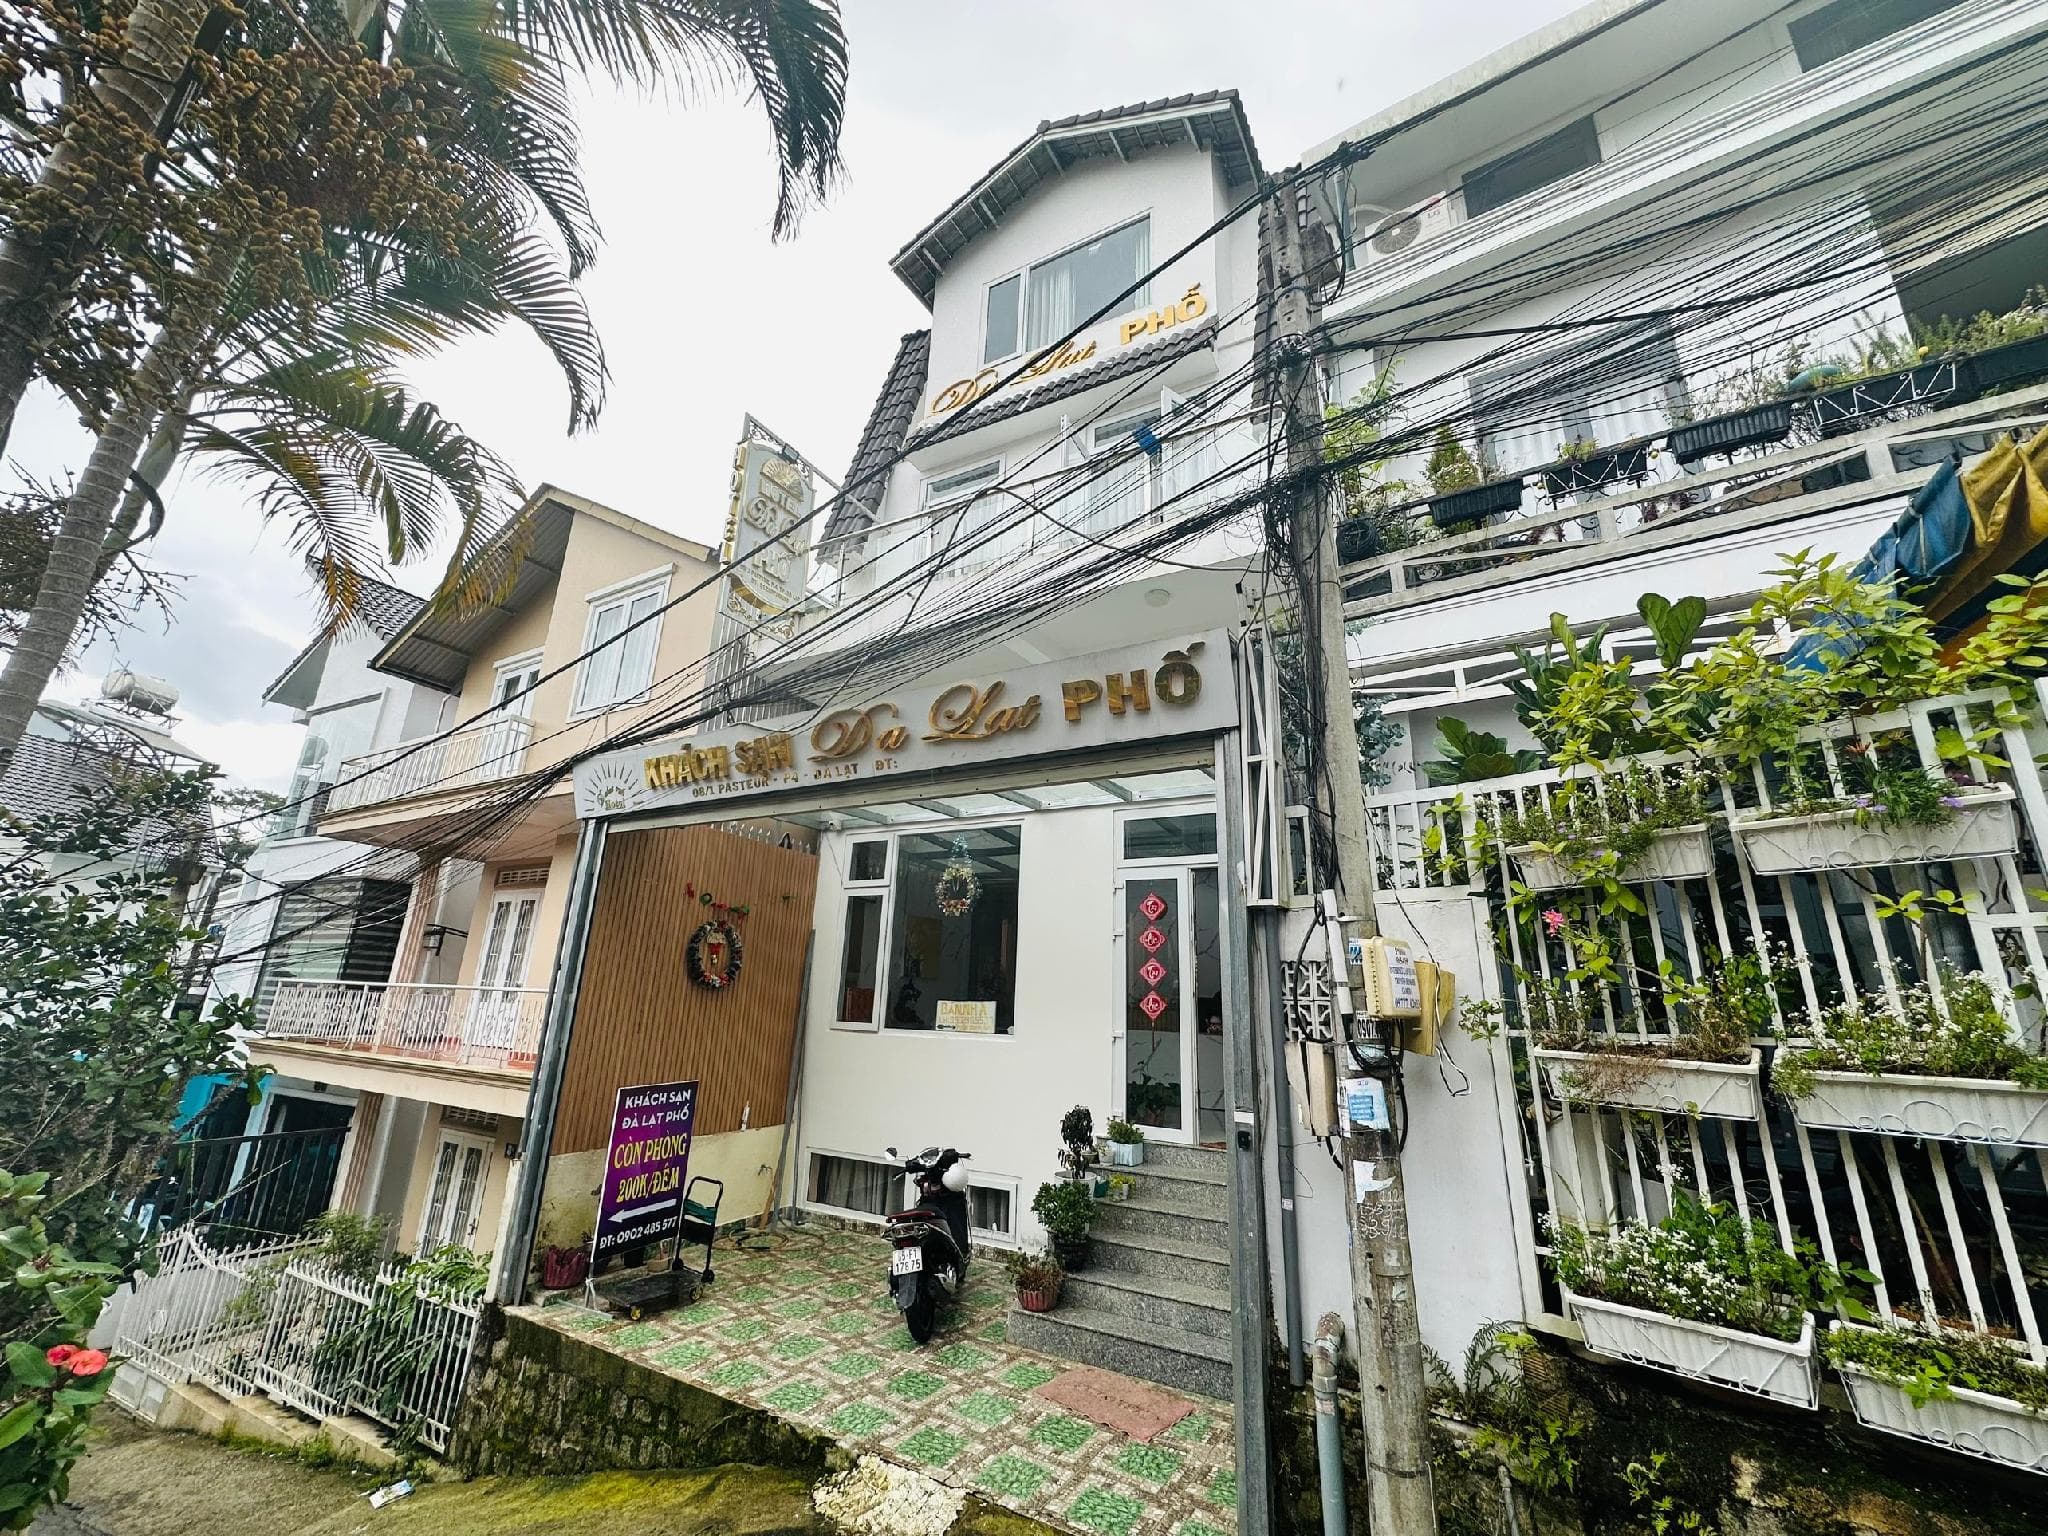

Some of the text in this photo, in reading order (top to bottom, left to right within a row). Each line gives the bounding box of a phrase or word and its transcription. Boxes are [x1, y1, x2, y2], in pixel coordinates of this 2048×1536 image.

[1120, 282, 1207, 345] PHỐ
[644, 743, 729, 789] KHÁCH
[919, 680, 1040, 744] Lat
[1061, 641, 1206, 722] PHỐ
[718, 777, 769, 795] PASTEUR
[624, 1089, 692, 1109] KHÁCH SẠN
[641, 1113, 663, 1129] LẠT
[665, 1104, 690, 1122] PHỐ
[614, 1130, 687, 1169] CÒN PHÒNG
[599, 1235, 615, 1250] ĐT:
[616, 1227, 642, 1244] 0902
[661, 1216, 678, 1231] 577
